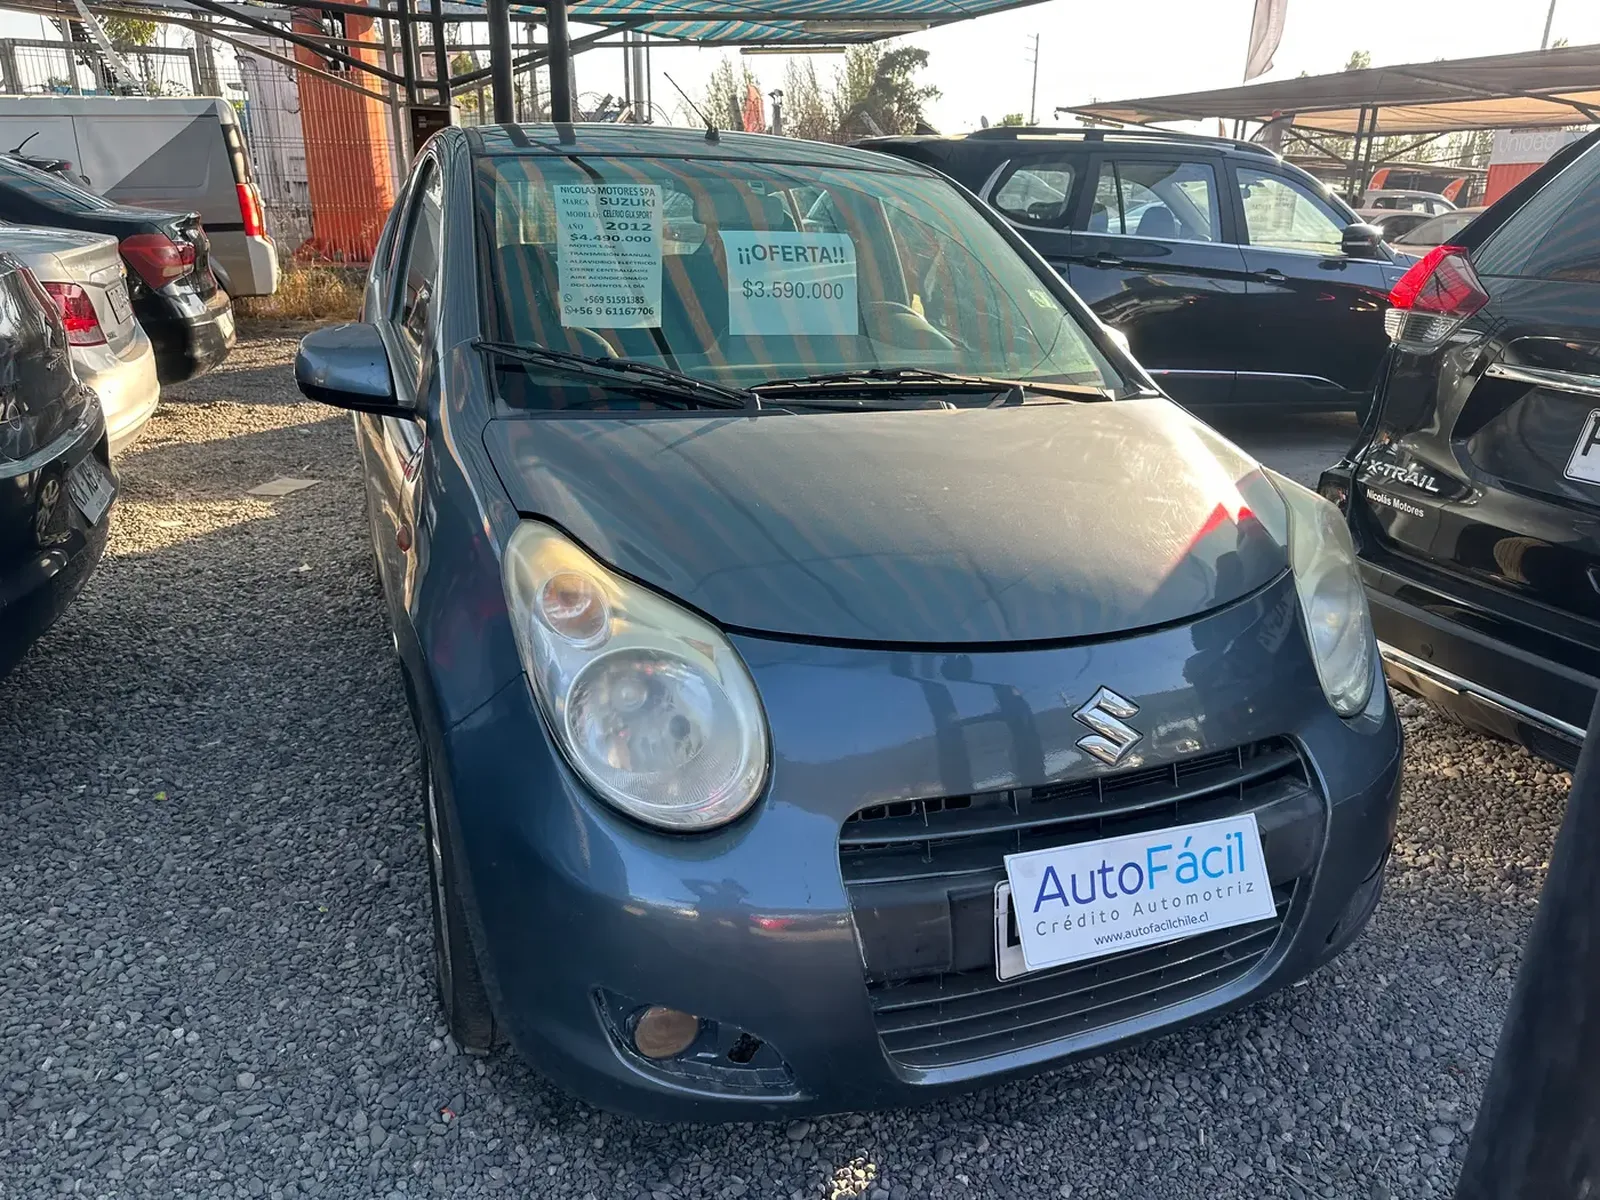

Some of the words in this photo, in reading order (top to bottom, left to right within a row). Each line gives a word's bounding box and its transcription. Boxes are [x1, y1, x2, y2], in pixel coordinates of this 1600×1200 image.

[560, 186, 597, 195] NICOLAS
[597, 186, 638, 196] MOTORES
[639, 187, 656, 197] SPA
[562, 198, 590, 206] MARCA
[599, 196, 656, 207] SUZUKI
[602, 209, 625, 219] CELERIO
[635, 210, 653, 220] SPORT
[567, 222, 584, 231] AÑO
[606, 222, 652, 231] 2012
[570, 233, 651, 242] $4.490.000
[737, 243, 845, 265] ¡¡OFERTA!!
[742, 278, 844, 300] $3.590.000
[583, 295, 605, 304] +569
[606, 295, 645, 305] 51591385
[573, 306, 593, 315] +56
[595, 307, 603, 316] 9
[605, 306, 655, 316] 61167706
[1366, 460, 1440, 493] X-TRAIL
[1366, 488, 1392, 507] Nicolás
[1392, 497, 1425, 518] Motores
[1033, 831, 1246, 914] AutoFácil
[1035, 909, 1121, 938] Crédito
[1131, 880, 1256, 918] Automotriz
[1093, 911, 1210, 947] www.autofacilchile.cl
